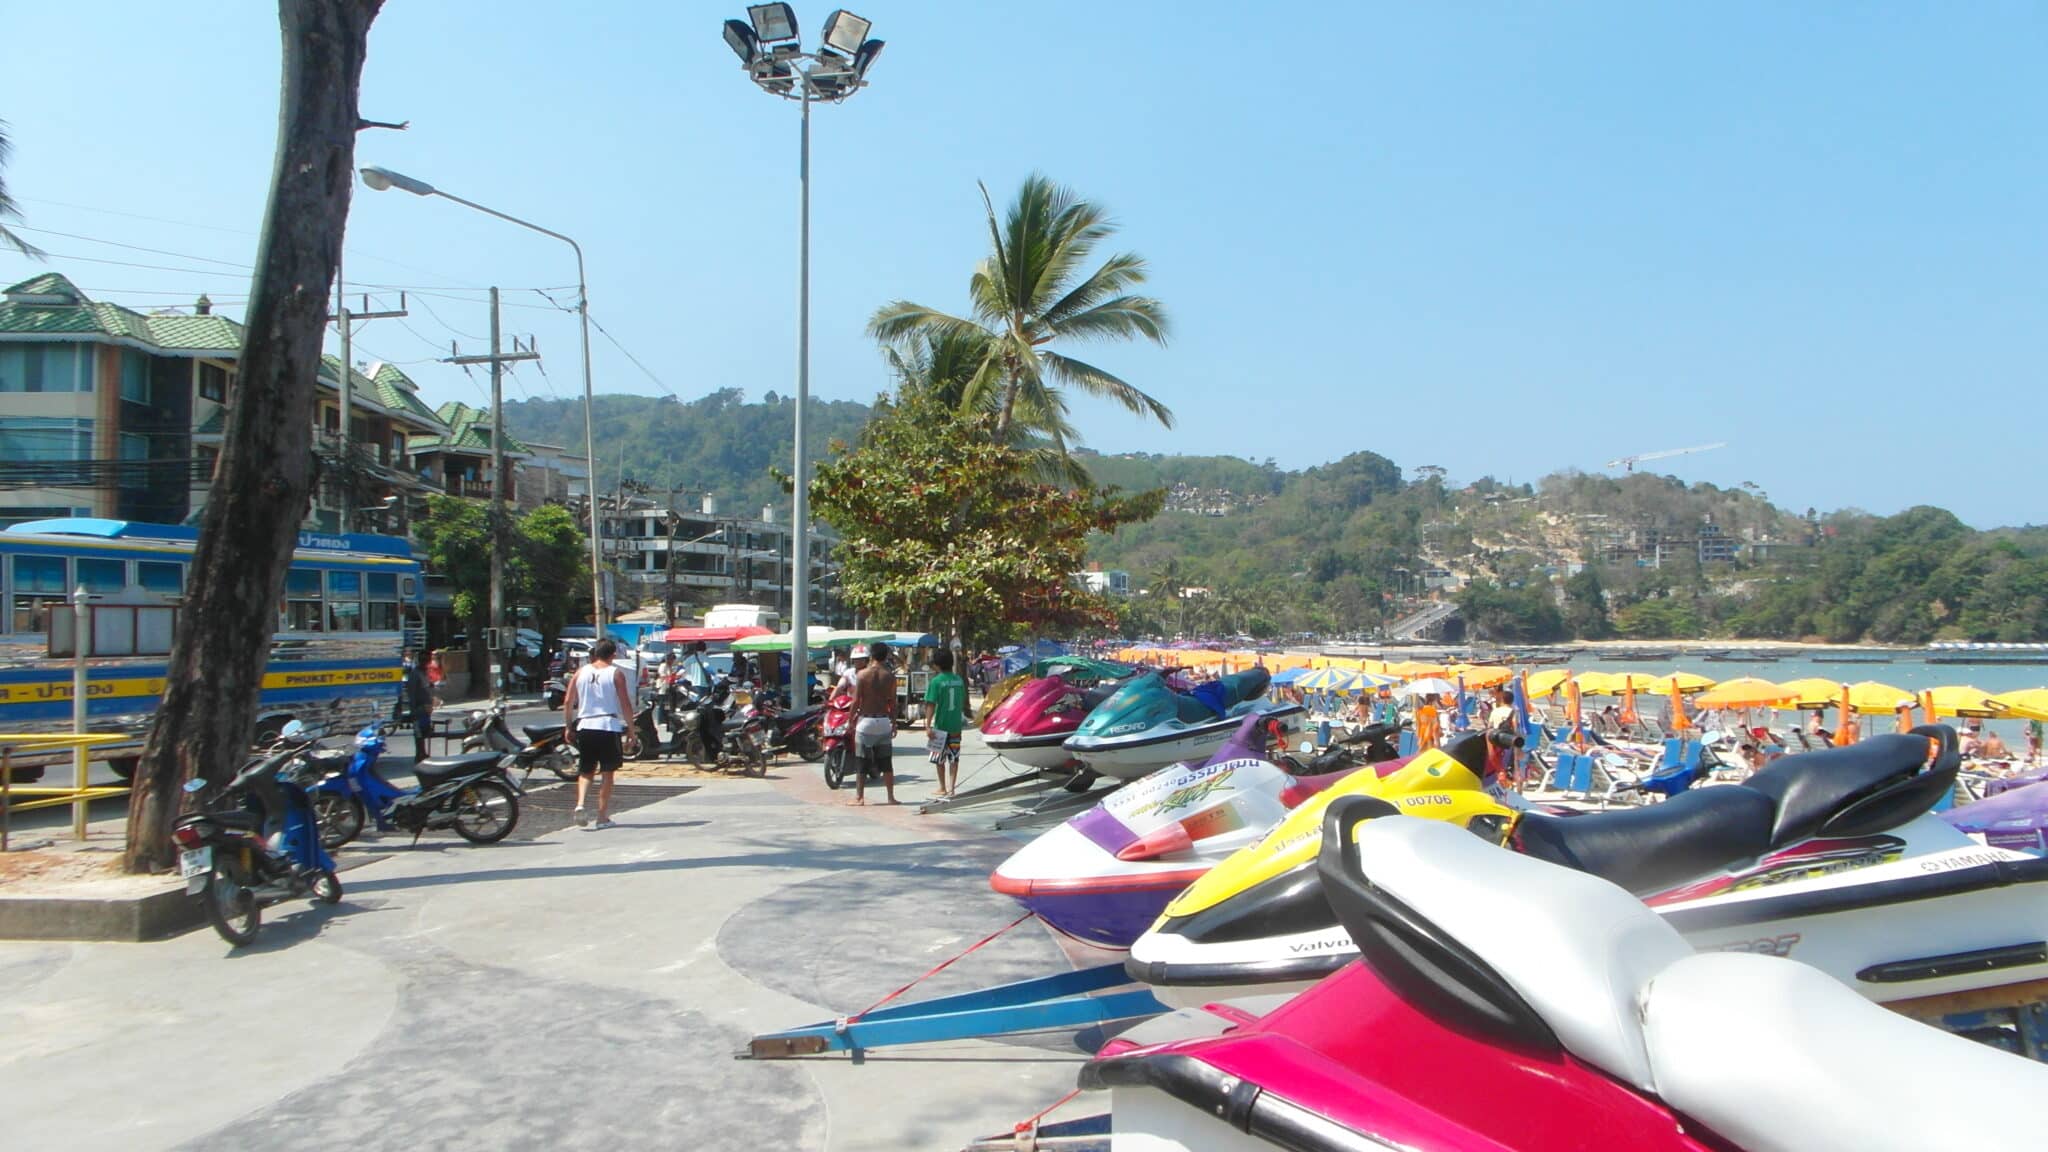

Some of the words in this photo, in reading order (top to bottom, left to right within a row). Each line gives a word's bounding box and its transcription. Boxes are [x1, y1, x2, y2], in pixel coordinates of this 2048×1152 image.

[285, 673, 335, 684] PHUKET
[344, 671, 394, 681] PATONG
[1406, 794, 1452, 807] 00706
[1938, 851, 2013, 869] YAMAHA
[1289, 939, 1354, 953] Valvo
